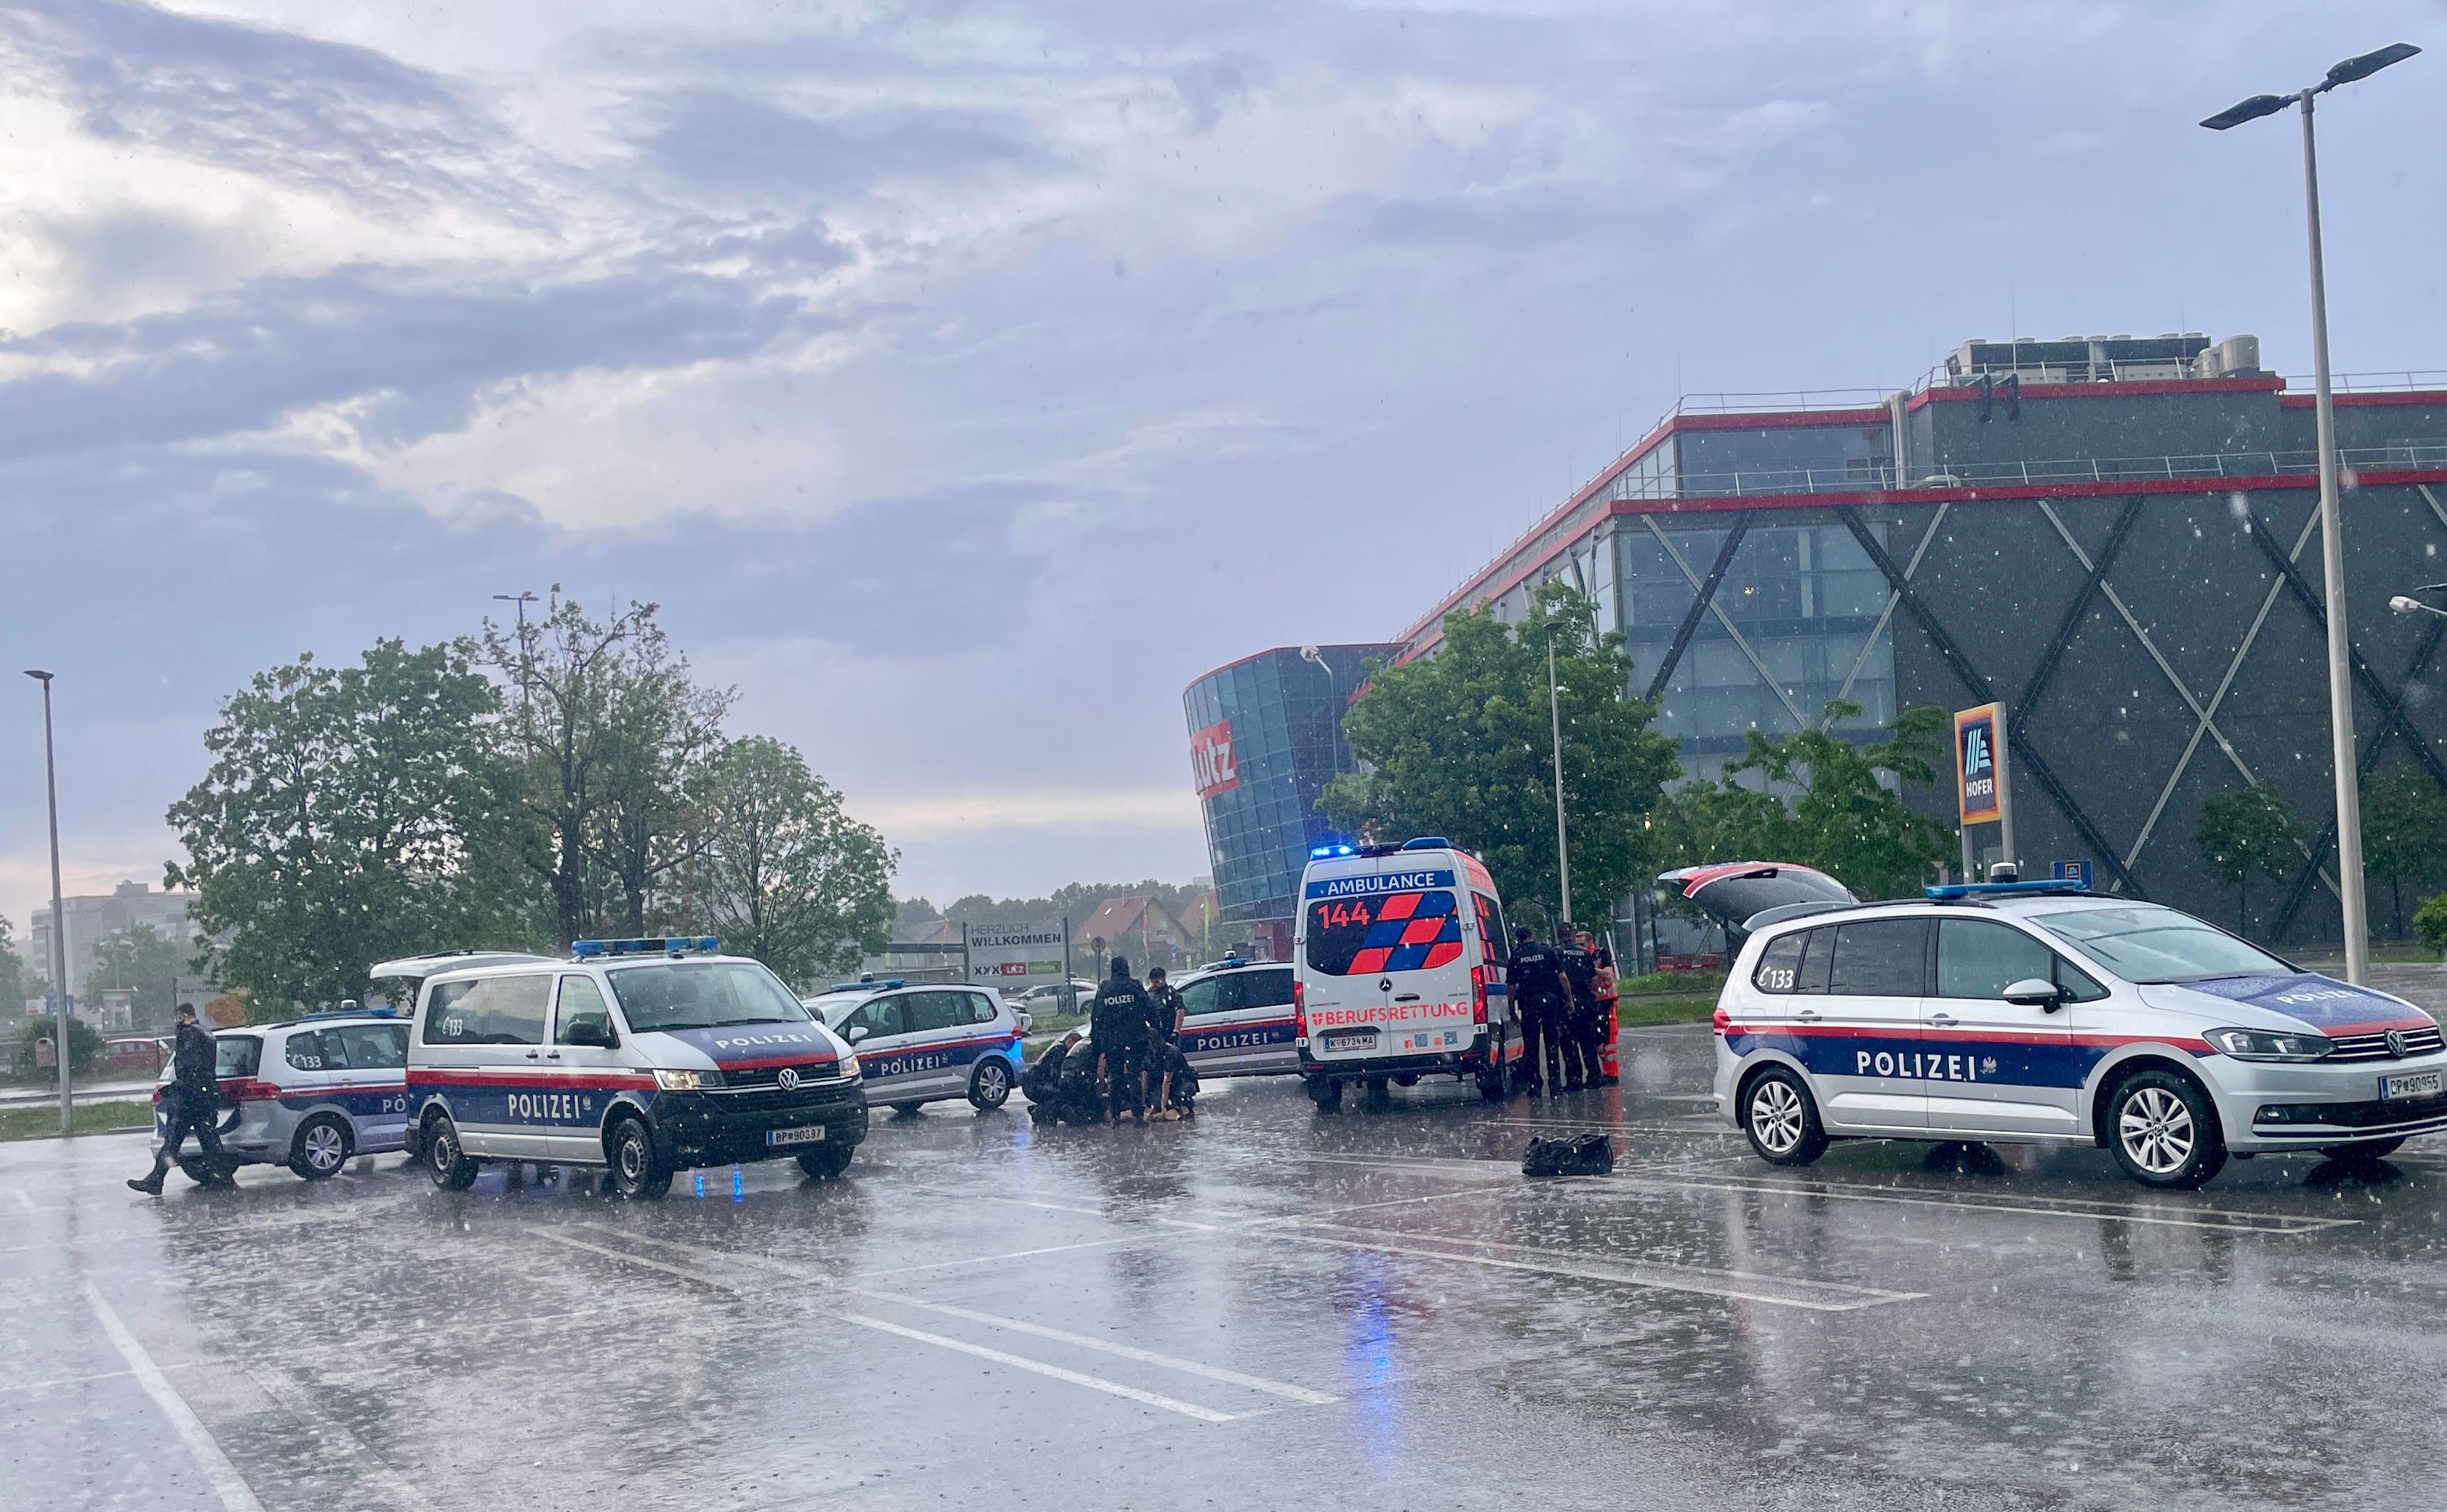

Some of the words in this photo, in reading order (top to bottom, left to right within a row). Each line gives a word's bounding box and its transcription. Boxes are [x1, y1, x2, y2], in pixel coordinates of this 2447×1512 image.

[1966, 778, 1993, 798] HOFER
[1327, 873, 1435, 896] AMBULANCE
[1318, 901, 1371, 930] 144
[971, 923, 1029, 934] HERZLICH
[971, 933, 1061, 947] WILLKOMMEN
[1520, 954, 1544, 963] POLIZEI
[1771, 969, 1794, 989] 133
[1326, 1001, 1468, 1026] BERUFSRETTUNG
[449, 1018, 463, 1036] 133
[715, 1034, 812, 1049] POLIZEI
[1198, 1032, 1268, 1051] POLIZEI
[1341, 1037, 1361, 1047] 6734
[1362, 1036, 1374, 1045] MA
[301, 1056, 322, 1068] 133
[881, 1055, 940, 1076] POLIZEI
[1856, 1051, 1976, 1082] POLIZEI
[508, 1093, 580, 1119] POLIZEI
[776, 1132, 787, 1143] BP
[794, 1129, 822, 1140] 90397
